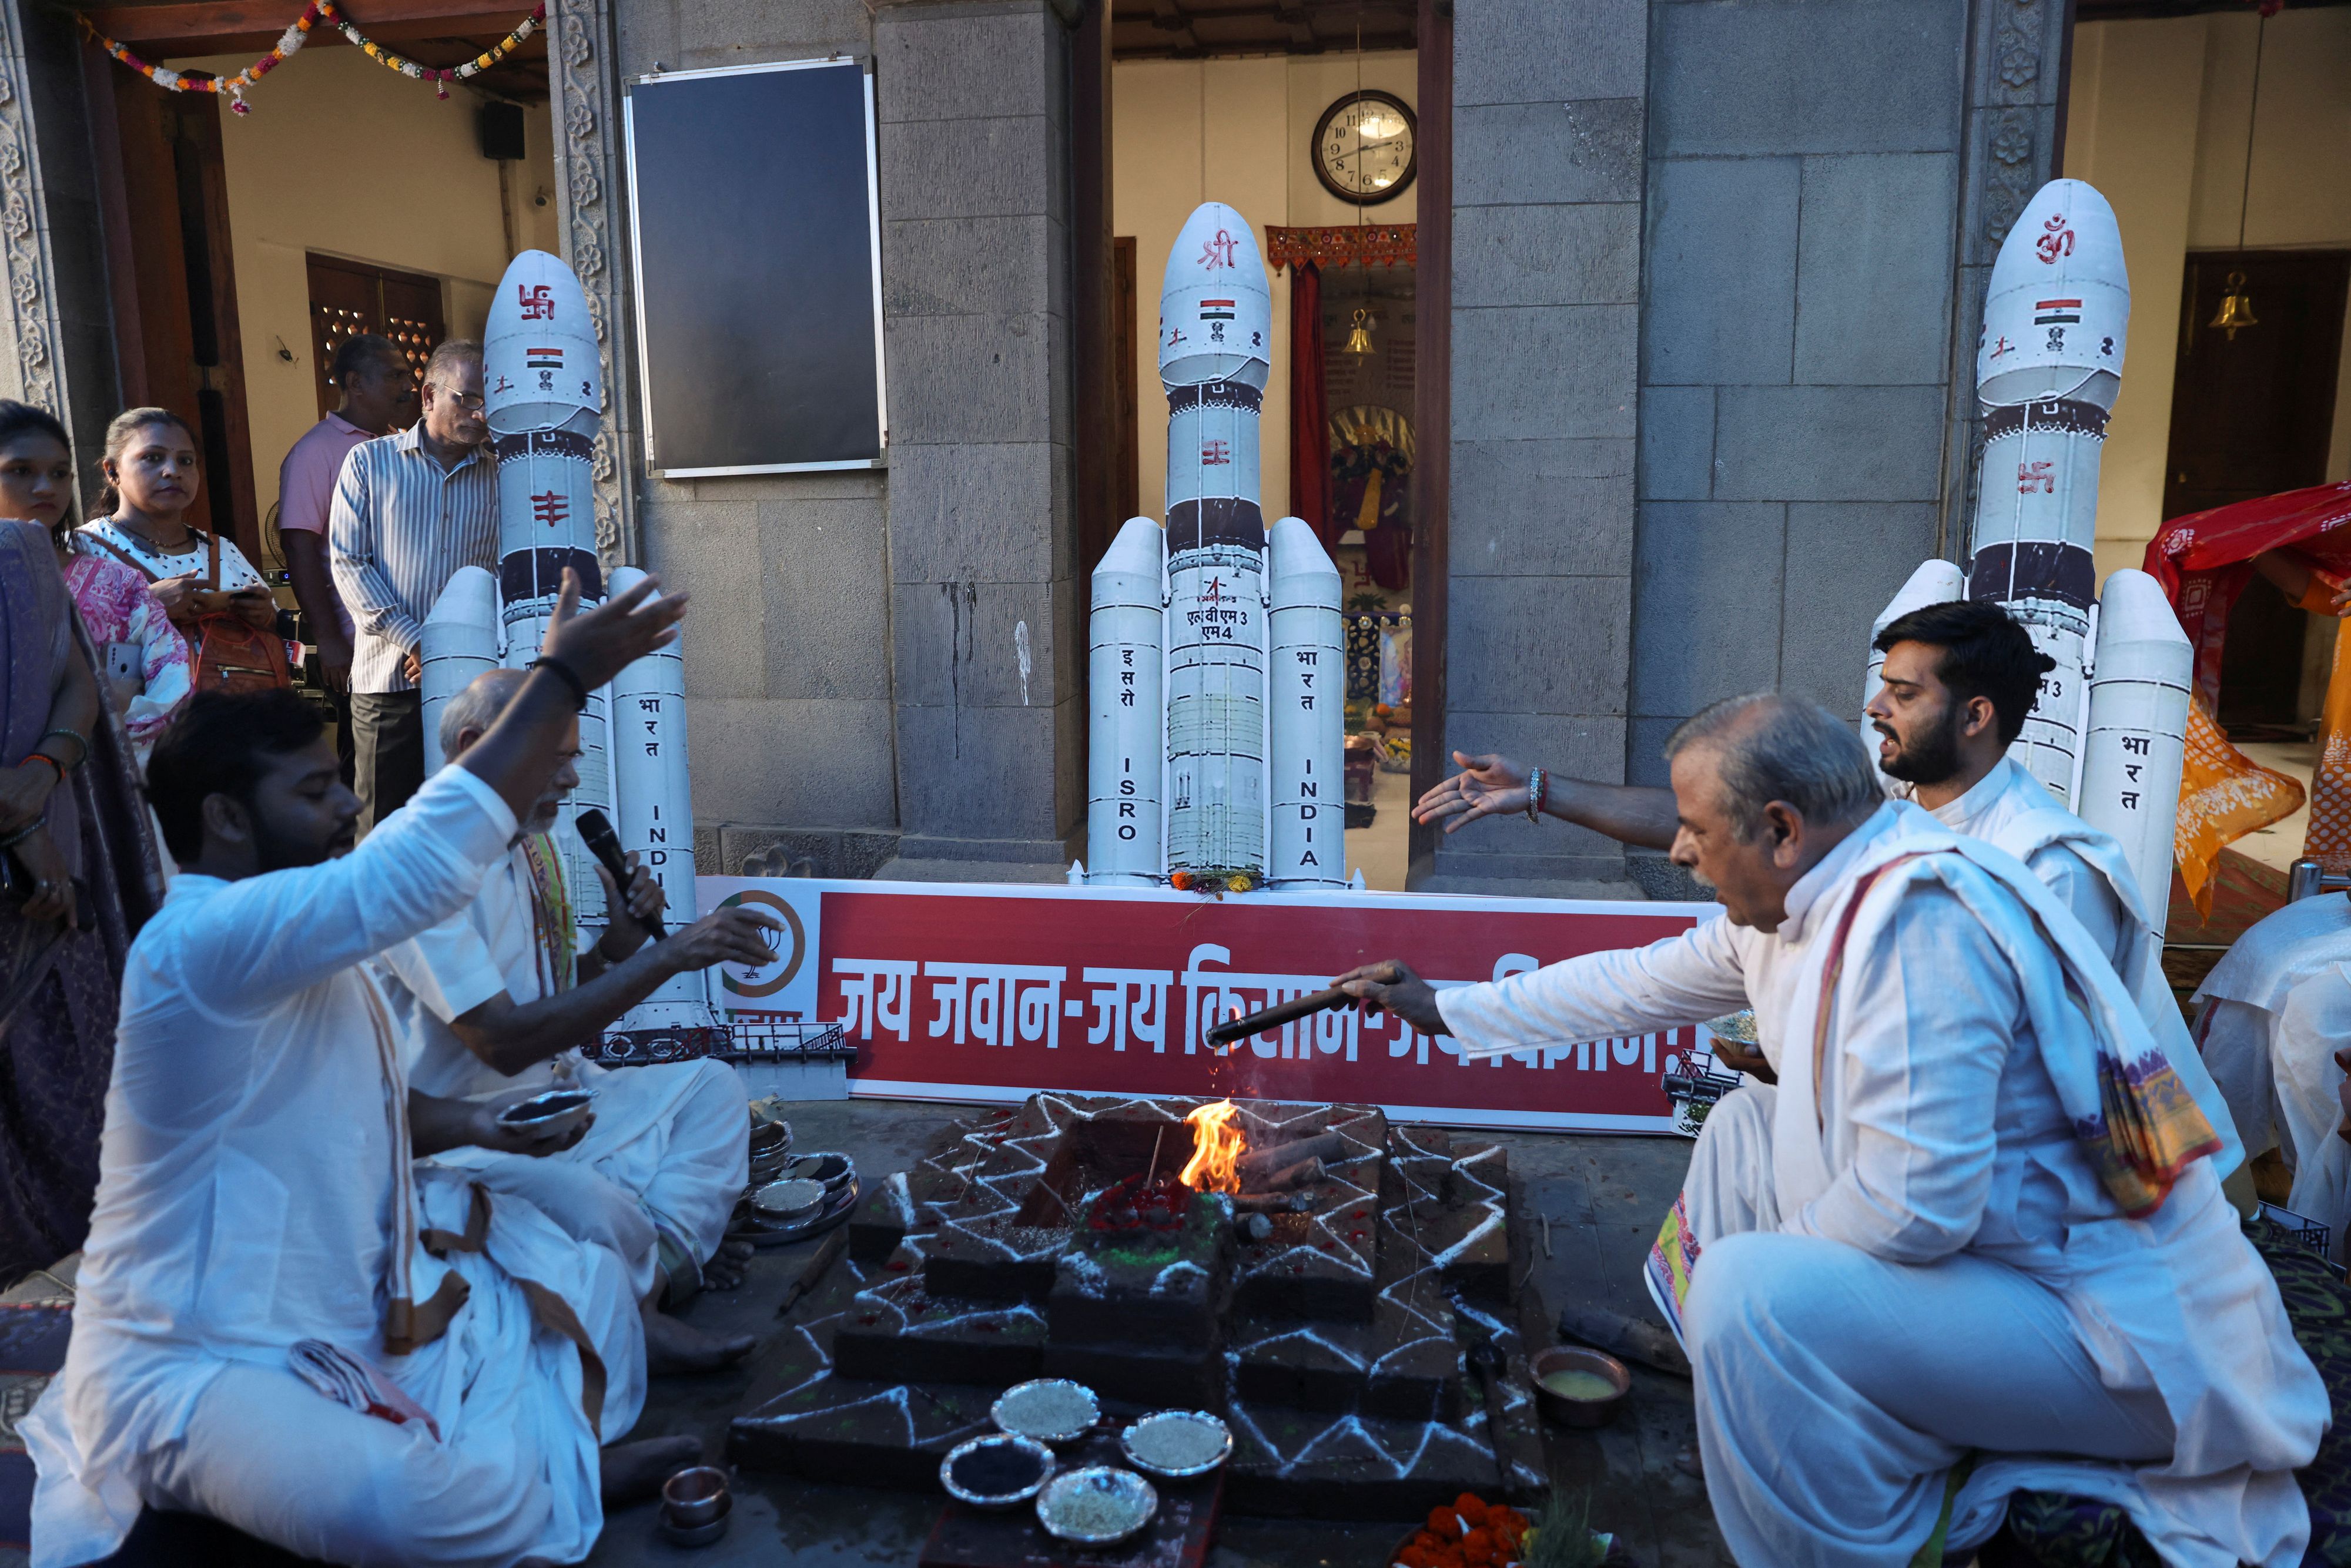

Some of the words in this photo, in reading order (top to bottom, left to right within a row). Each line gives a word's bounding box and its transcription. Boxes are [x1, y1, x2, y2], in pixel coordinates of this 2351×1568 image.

[1347, 115, 1355, 126] 11
[1335, 127, 1346, 139] 10
[1330, 143, 1340, 155] 9
[1395, 140, 1404, 152] 3
[1335, 159, 1345, 171] 8
[1391, 155, 1399, 167] 4
[1347, 170, 1355, 182] 7
[1362, 174, 1372, 186] 6
[1197, 229, 1239, 271] श्री
[1118, 758, 1136, 840] ISRO
[1300, 760, 1318, 866] INDIA
[650, 806, 671, 910] INDI
[832, 958, 918, 1042] जय
